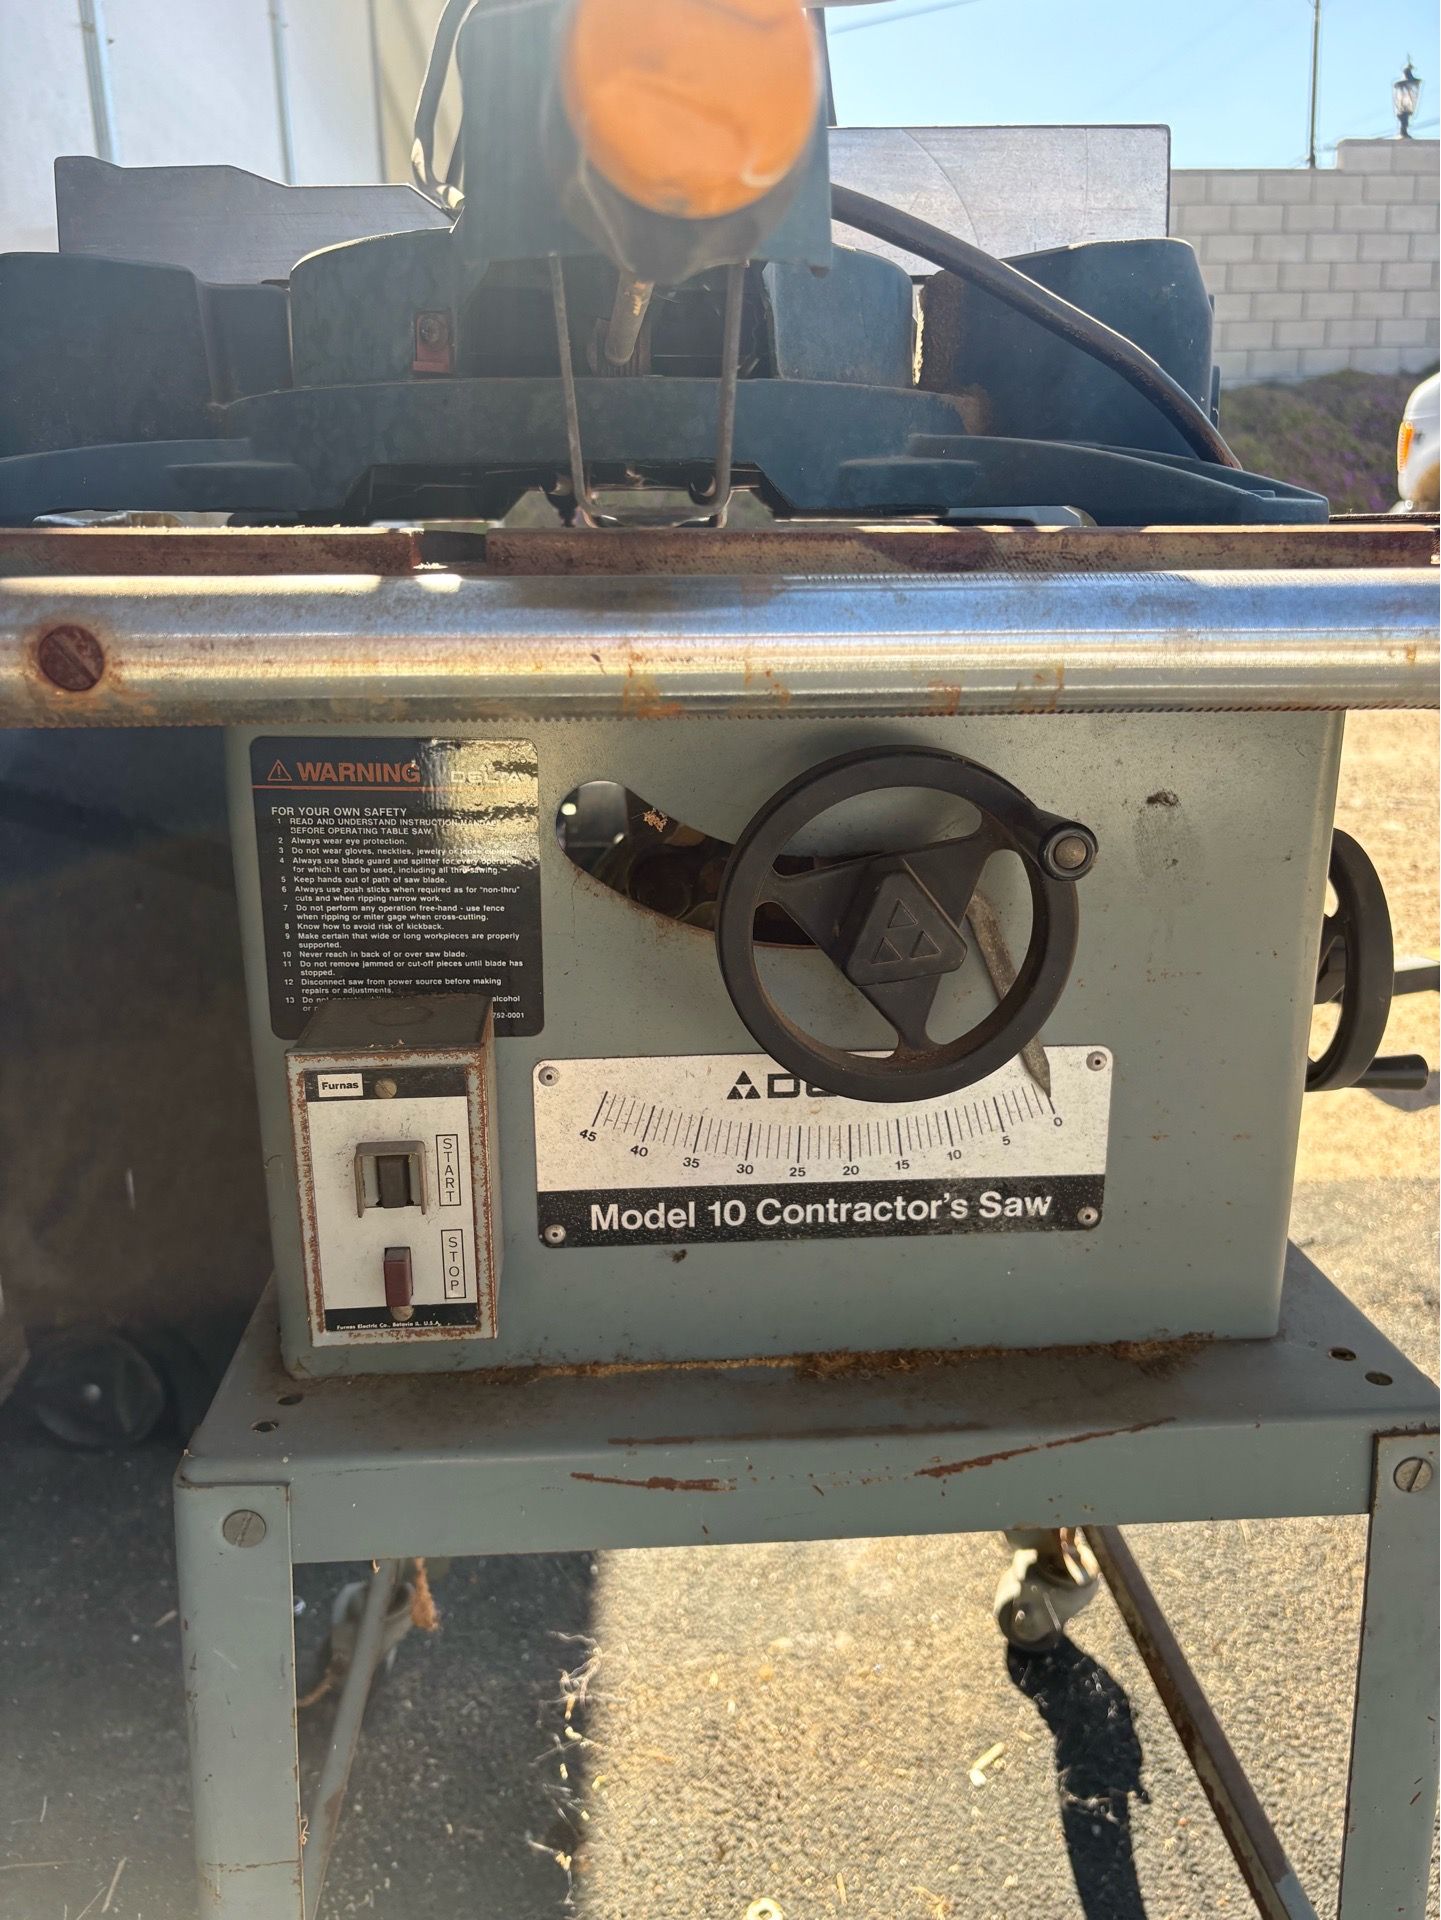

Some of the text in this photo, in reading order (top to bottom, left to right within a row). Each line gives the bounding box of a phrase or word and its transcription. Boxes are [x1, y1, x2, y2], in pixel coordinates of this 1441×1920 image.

[296, 762, 420, 783] WARNING
[271, 806, 406, 816] FOR YOUR OWN SAFETY
[289, 817, 313, 825] READ
[411, 826, 435, 835] SAW.
[291, 837, 320, 845] Always
[344, 847, 374, 855] gloves,
[377, 847, 414, 855] neckties,
[417, 848, 445, 856] jewelry
[292, 857, 321, 867] Always
[366, 857, 390, 865] guard
[411, 857, 439, 866] splitter
[398, 866, 435, 875] including
[293, 876, 314, 884] Keep
[372, 876, 390, 884] path
[294, 885, 323, 894] Always
[343, 885, 363, 894] push
[417, 886, 451, 894] required
[357, 895, 386, 903] ripping
[326, 904, 358, 912] perform
[321, 913, 349, 921] ripping
[433, 913, 488, 921] cross-cutting.
[403, 932, 421, 940] long
[423, 932, 469, 940] workpieces
[487, 932, 519, 940] properly
[298, 941, 341, 949] supported.
[362, 960, 393, 968] jammed
[436, 960, 462, 968] pieces
[300, 969, 335, 977] stopped.
[472, 977, 501, 985] making
[301, 987, 329, 995] repairs
[322, 1081, 359, 1090] Furnas
[580, 1117, 1063, 1177] 45 40 35 30 25 20 15 10 5 0
[442, 1137, 455, 1203] START
[590, 1190, 1051, 1231] Model 10 Contractor's Saw
[448, 1236, 460, 1291] STOP
